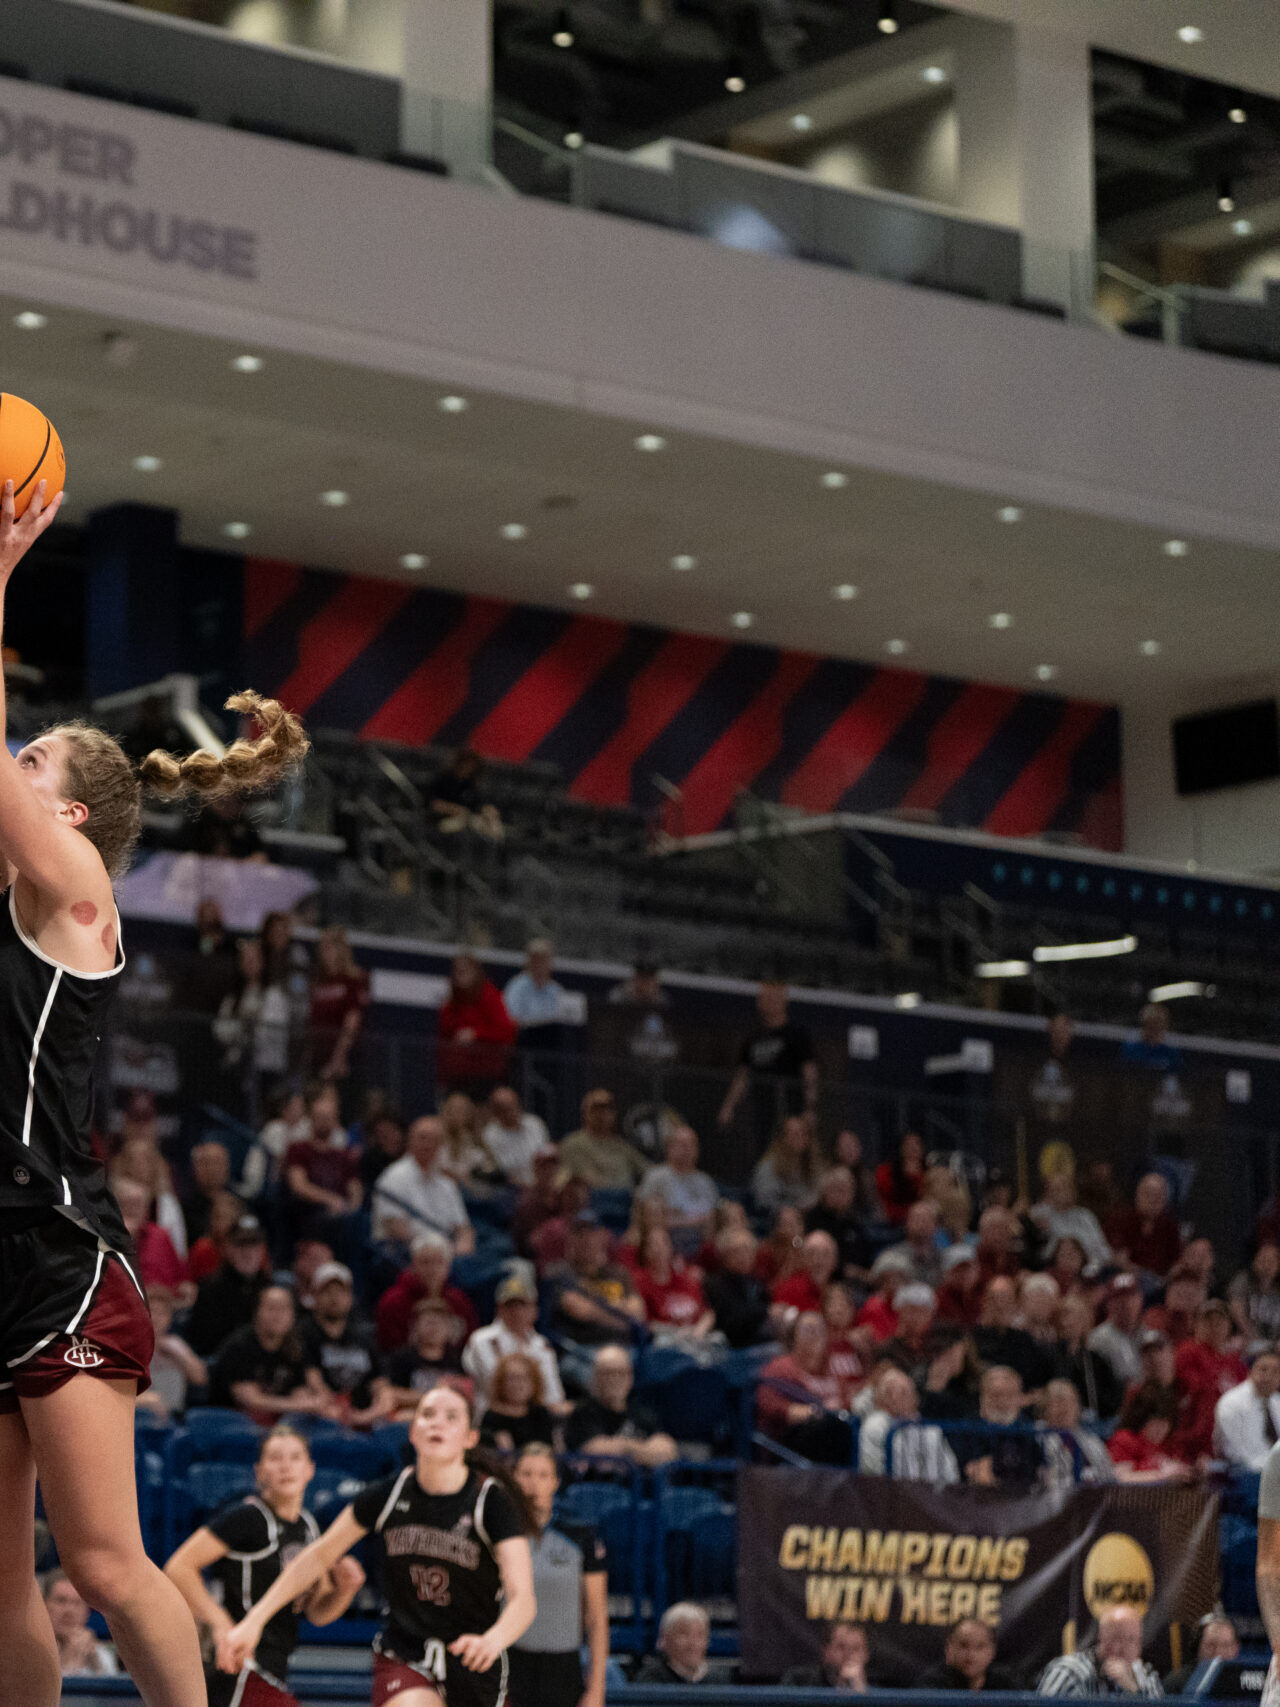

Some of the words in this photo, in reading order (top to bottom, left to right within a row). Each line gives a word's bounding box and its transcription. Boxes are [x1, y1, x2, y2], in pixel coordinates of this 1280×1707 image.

[778, 1523, 1029, 1581] CHAMPIONS
[409, 1563, 451, 1606] 12
[805, 1575, 894, 1624] WIN
[899, 1579, 1003, 1628] HERE
